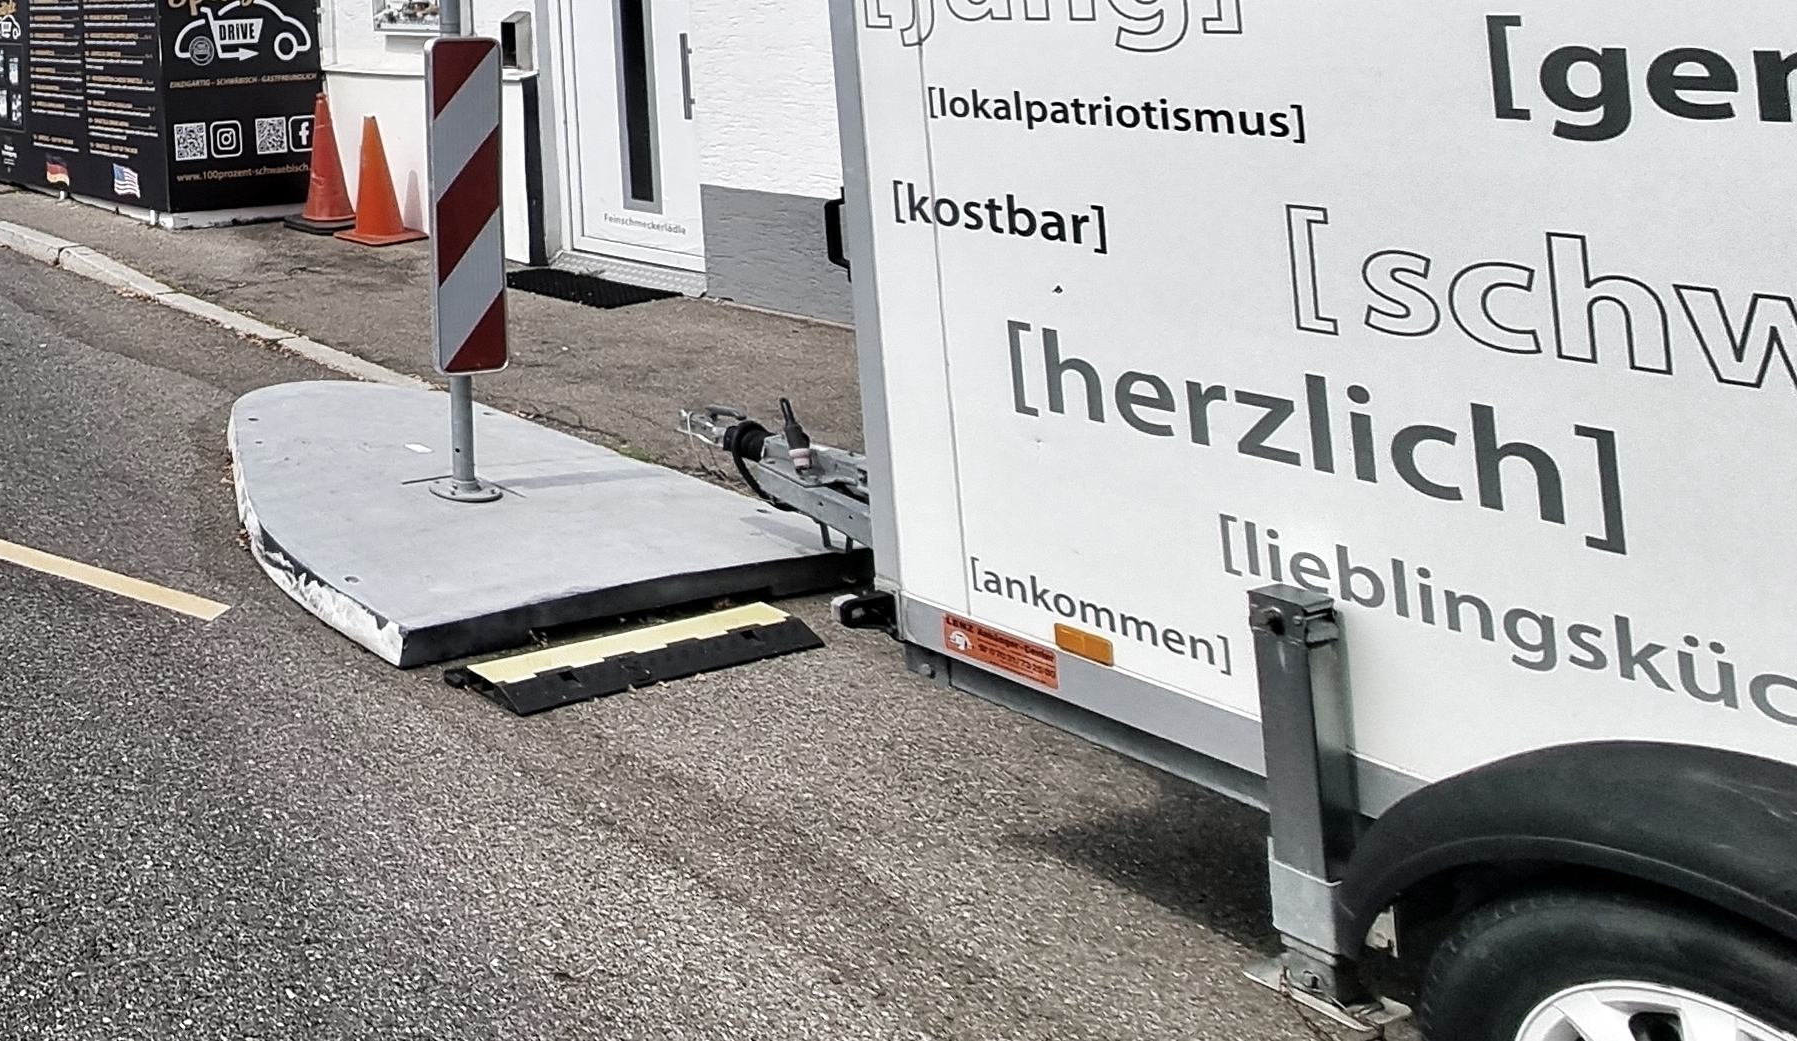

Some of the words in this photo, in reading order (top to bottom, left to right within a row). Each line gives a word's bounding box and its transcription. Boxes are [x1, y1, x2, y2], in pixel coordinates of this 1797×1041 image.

[927, 86, 1307, 144] [lokalpatriotismus]
[604, 212, 686, 235] Feinschmeckerlädle
[892, 180, 1109, 255] [kostbar]
[1007, 319, 1627, 556] [herzlich]
[946, 616, 975, 634] LENZ
[970, 556, 1232, 676] [ankommen]
